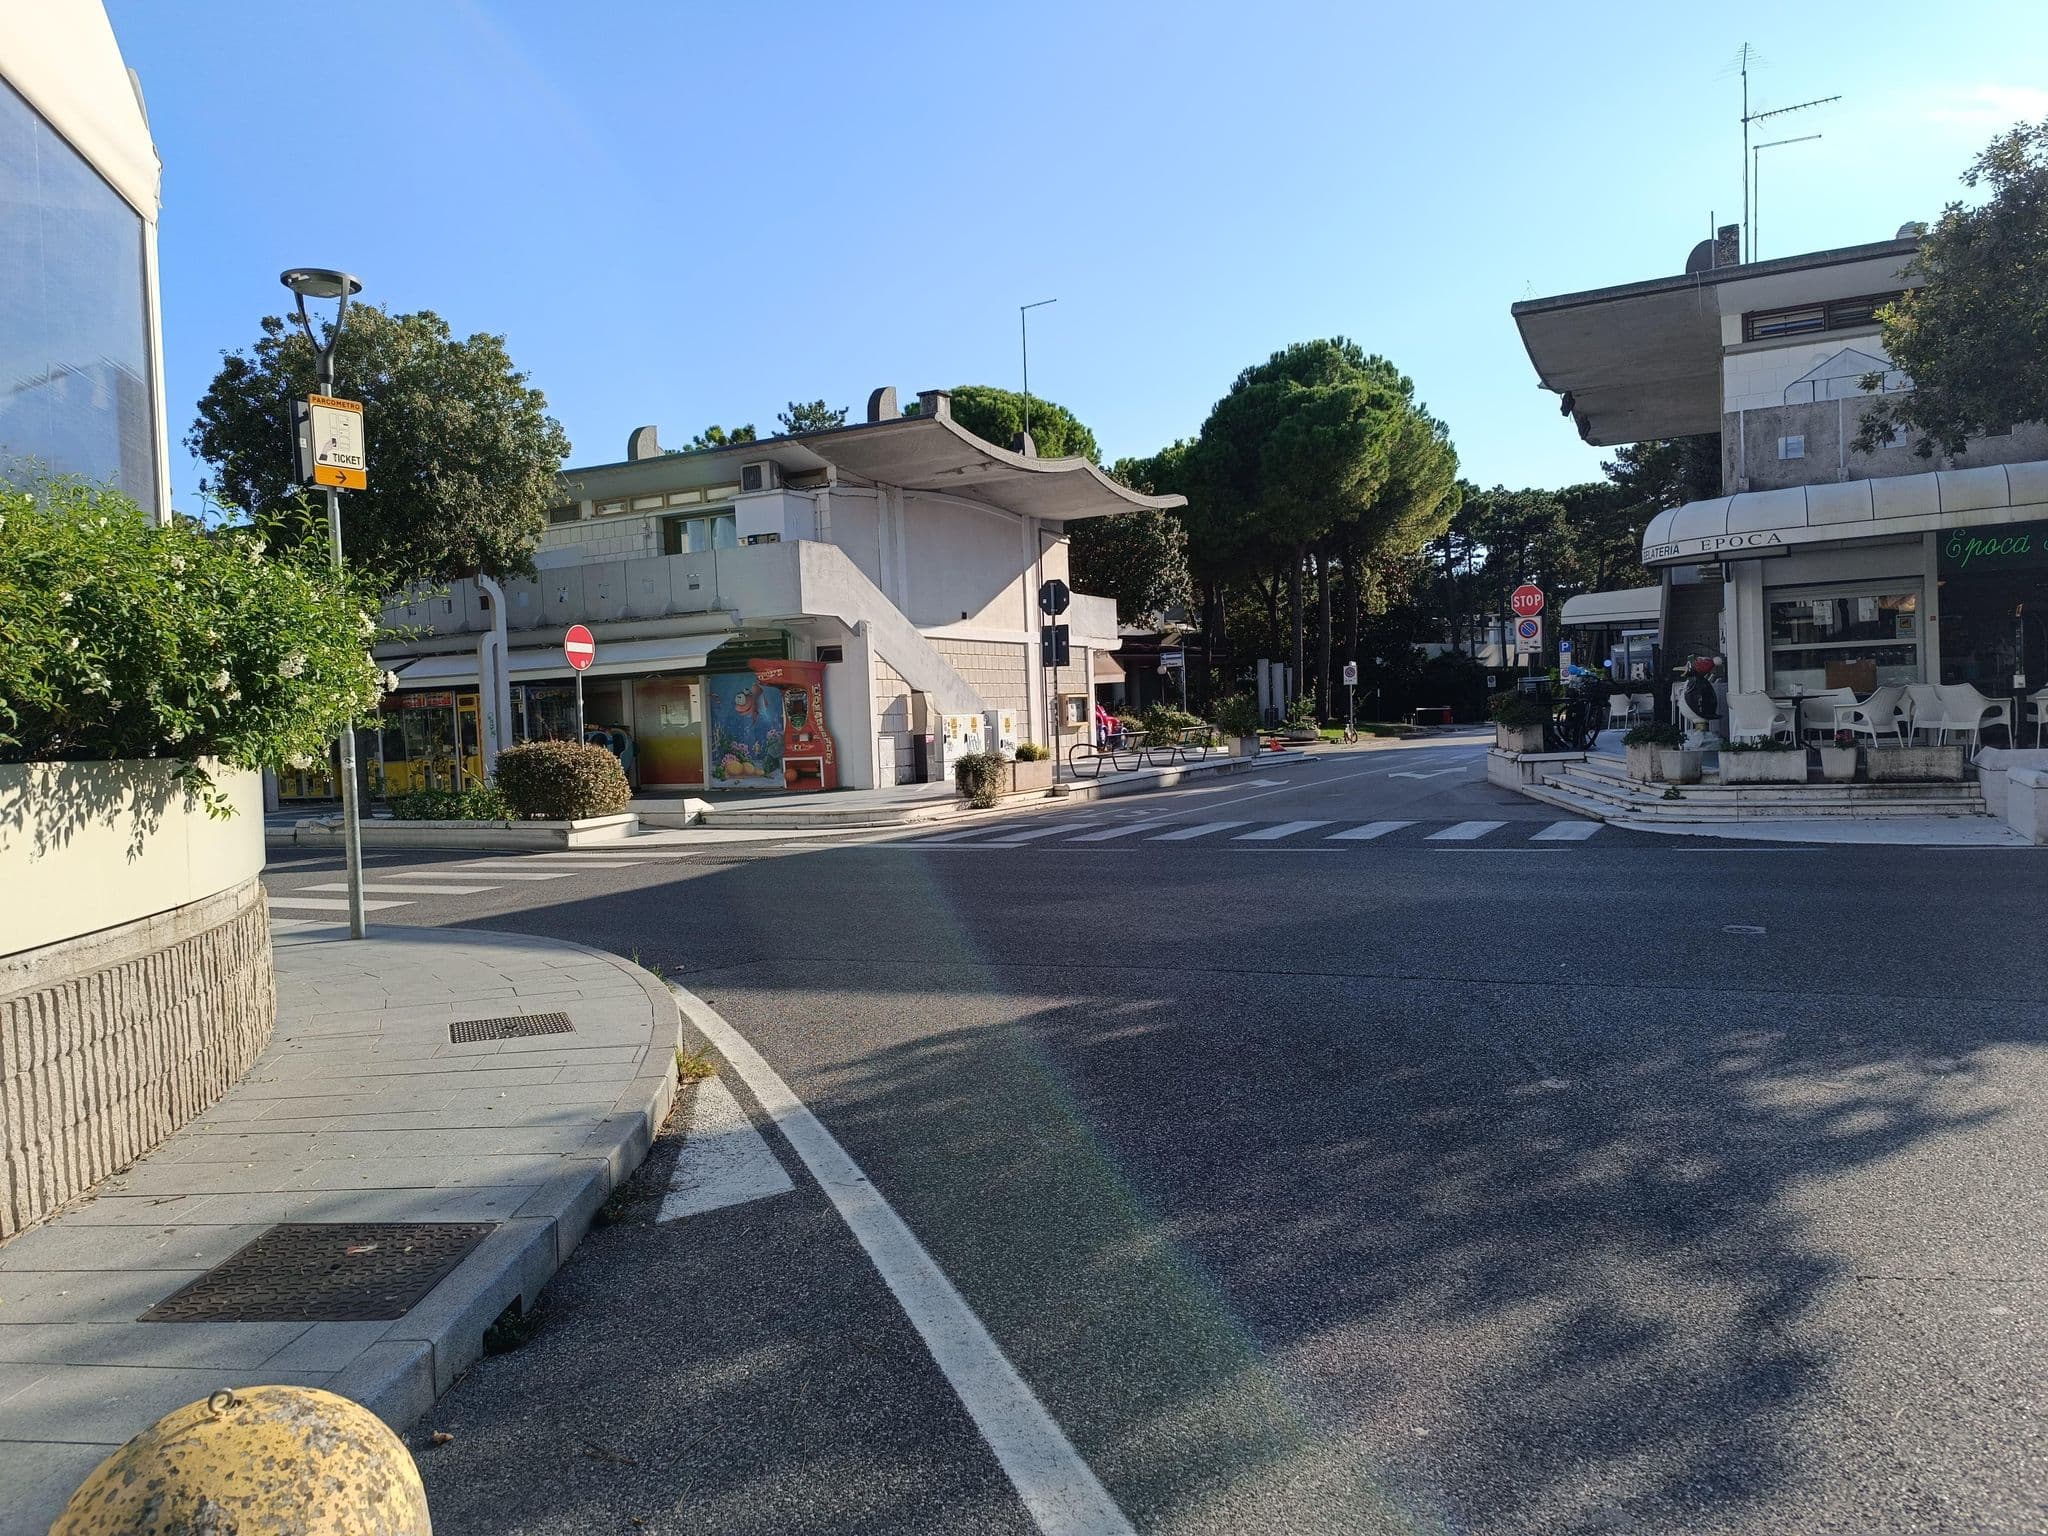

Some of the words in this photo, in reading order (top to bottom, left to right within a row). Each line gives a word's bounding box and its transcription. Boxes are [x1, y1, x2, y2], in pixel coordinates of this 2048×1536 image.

[312, 397, 360, 409] PARCOMETRO
[333, 453, 361, 465] TICKET
[1701, 533, 1782, 551] EPOCA
[1946, 529, 2031, 568] Epoca
[1513, 595, 1541, 607] STOP
[1561, 643, 1569, 651] P
